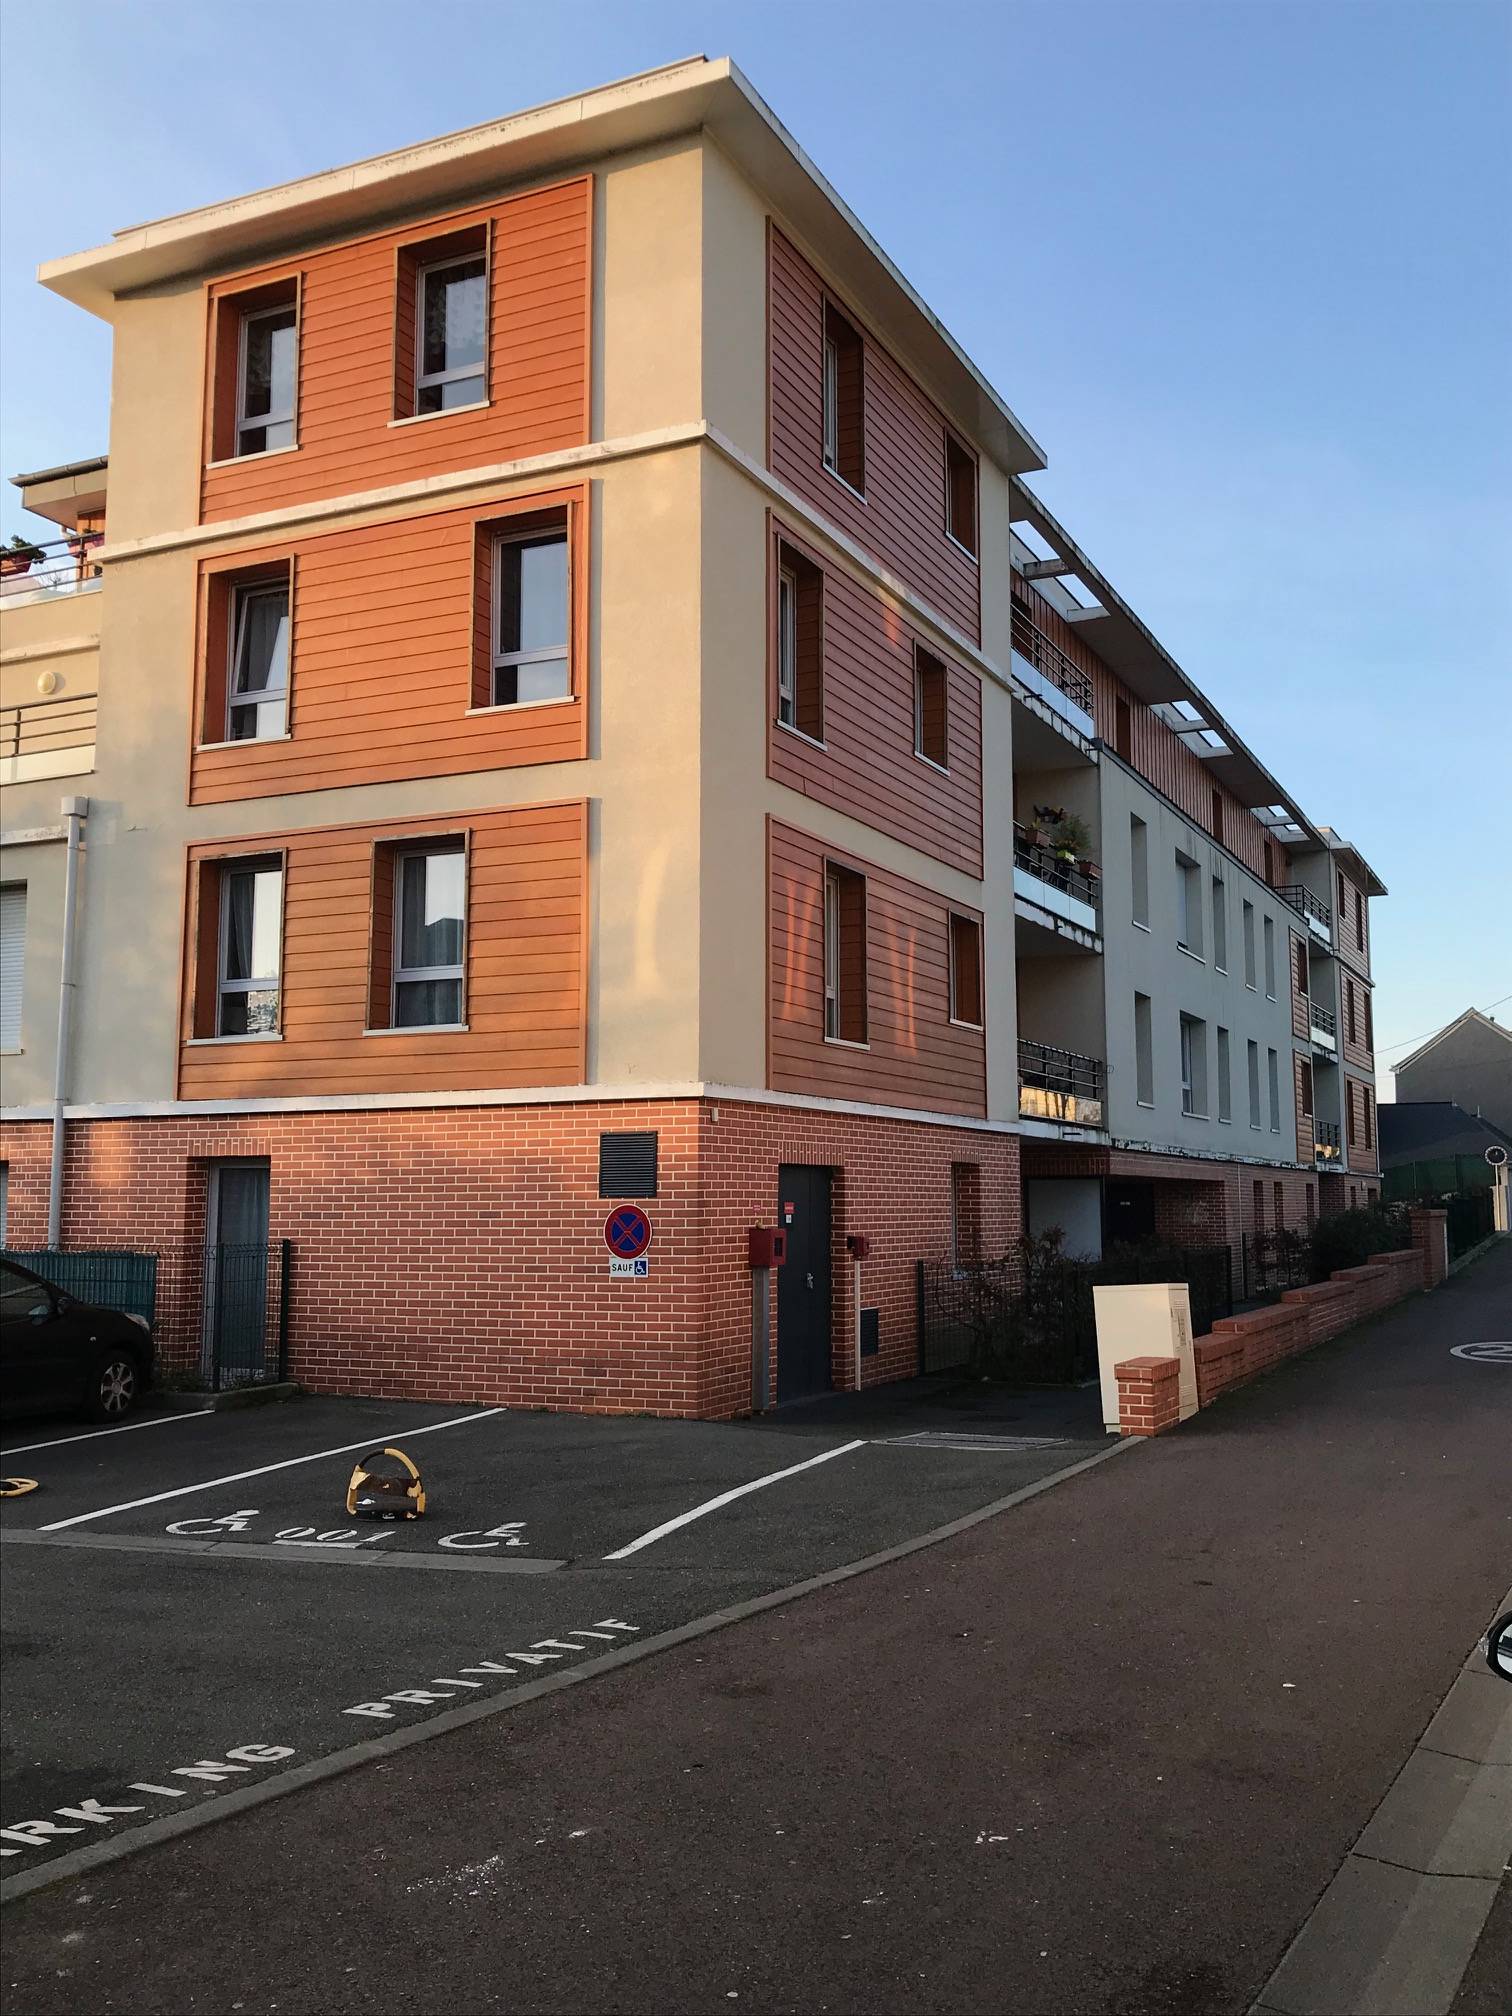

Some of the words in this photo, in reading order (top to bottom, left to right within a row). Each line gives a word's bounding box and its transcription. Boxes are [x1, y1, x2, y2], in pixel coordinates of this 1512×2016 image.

[612, 1263, 634, 1272] SAUF
[274, 1527, 396, 1542] 001
[0, 1743, 296, 1857] RKING
[342, 1618, 641, 1720] PRIVATIF
